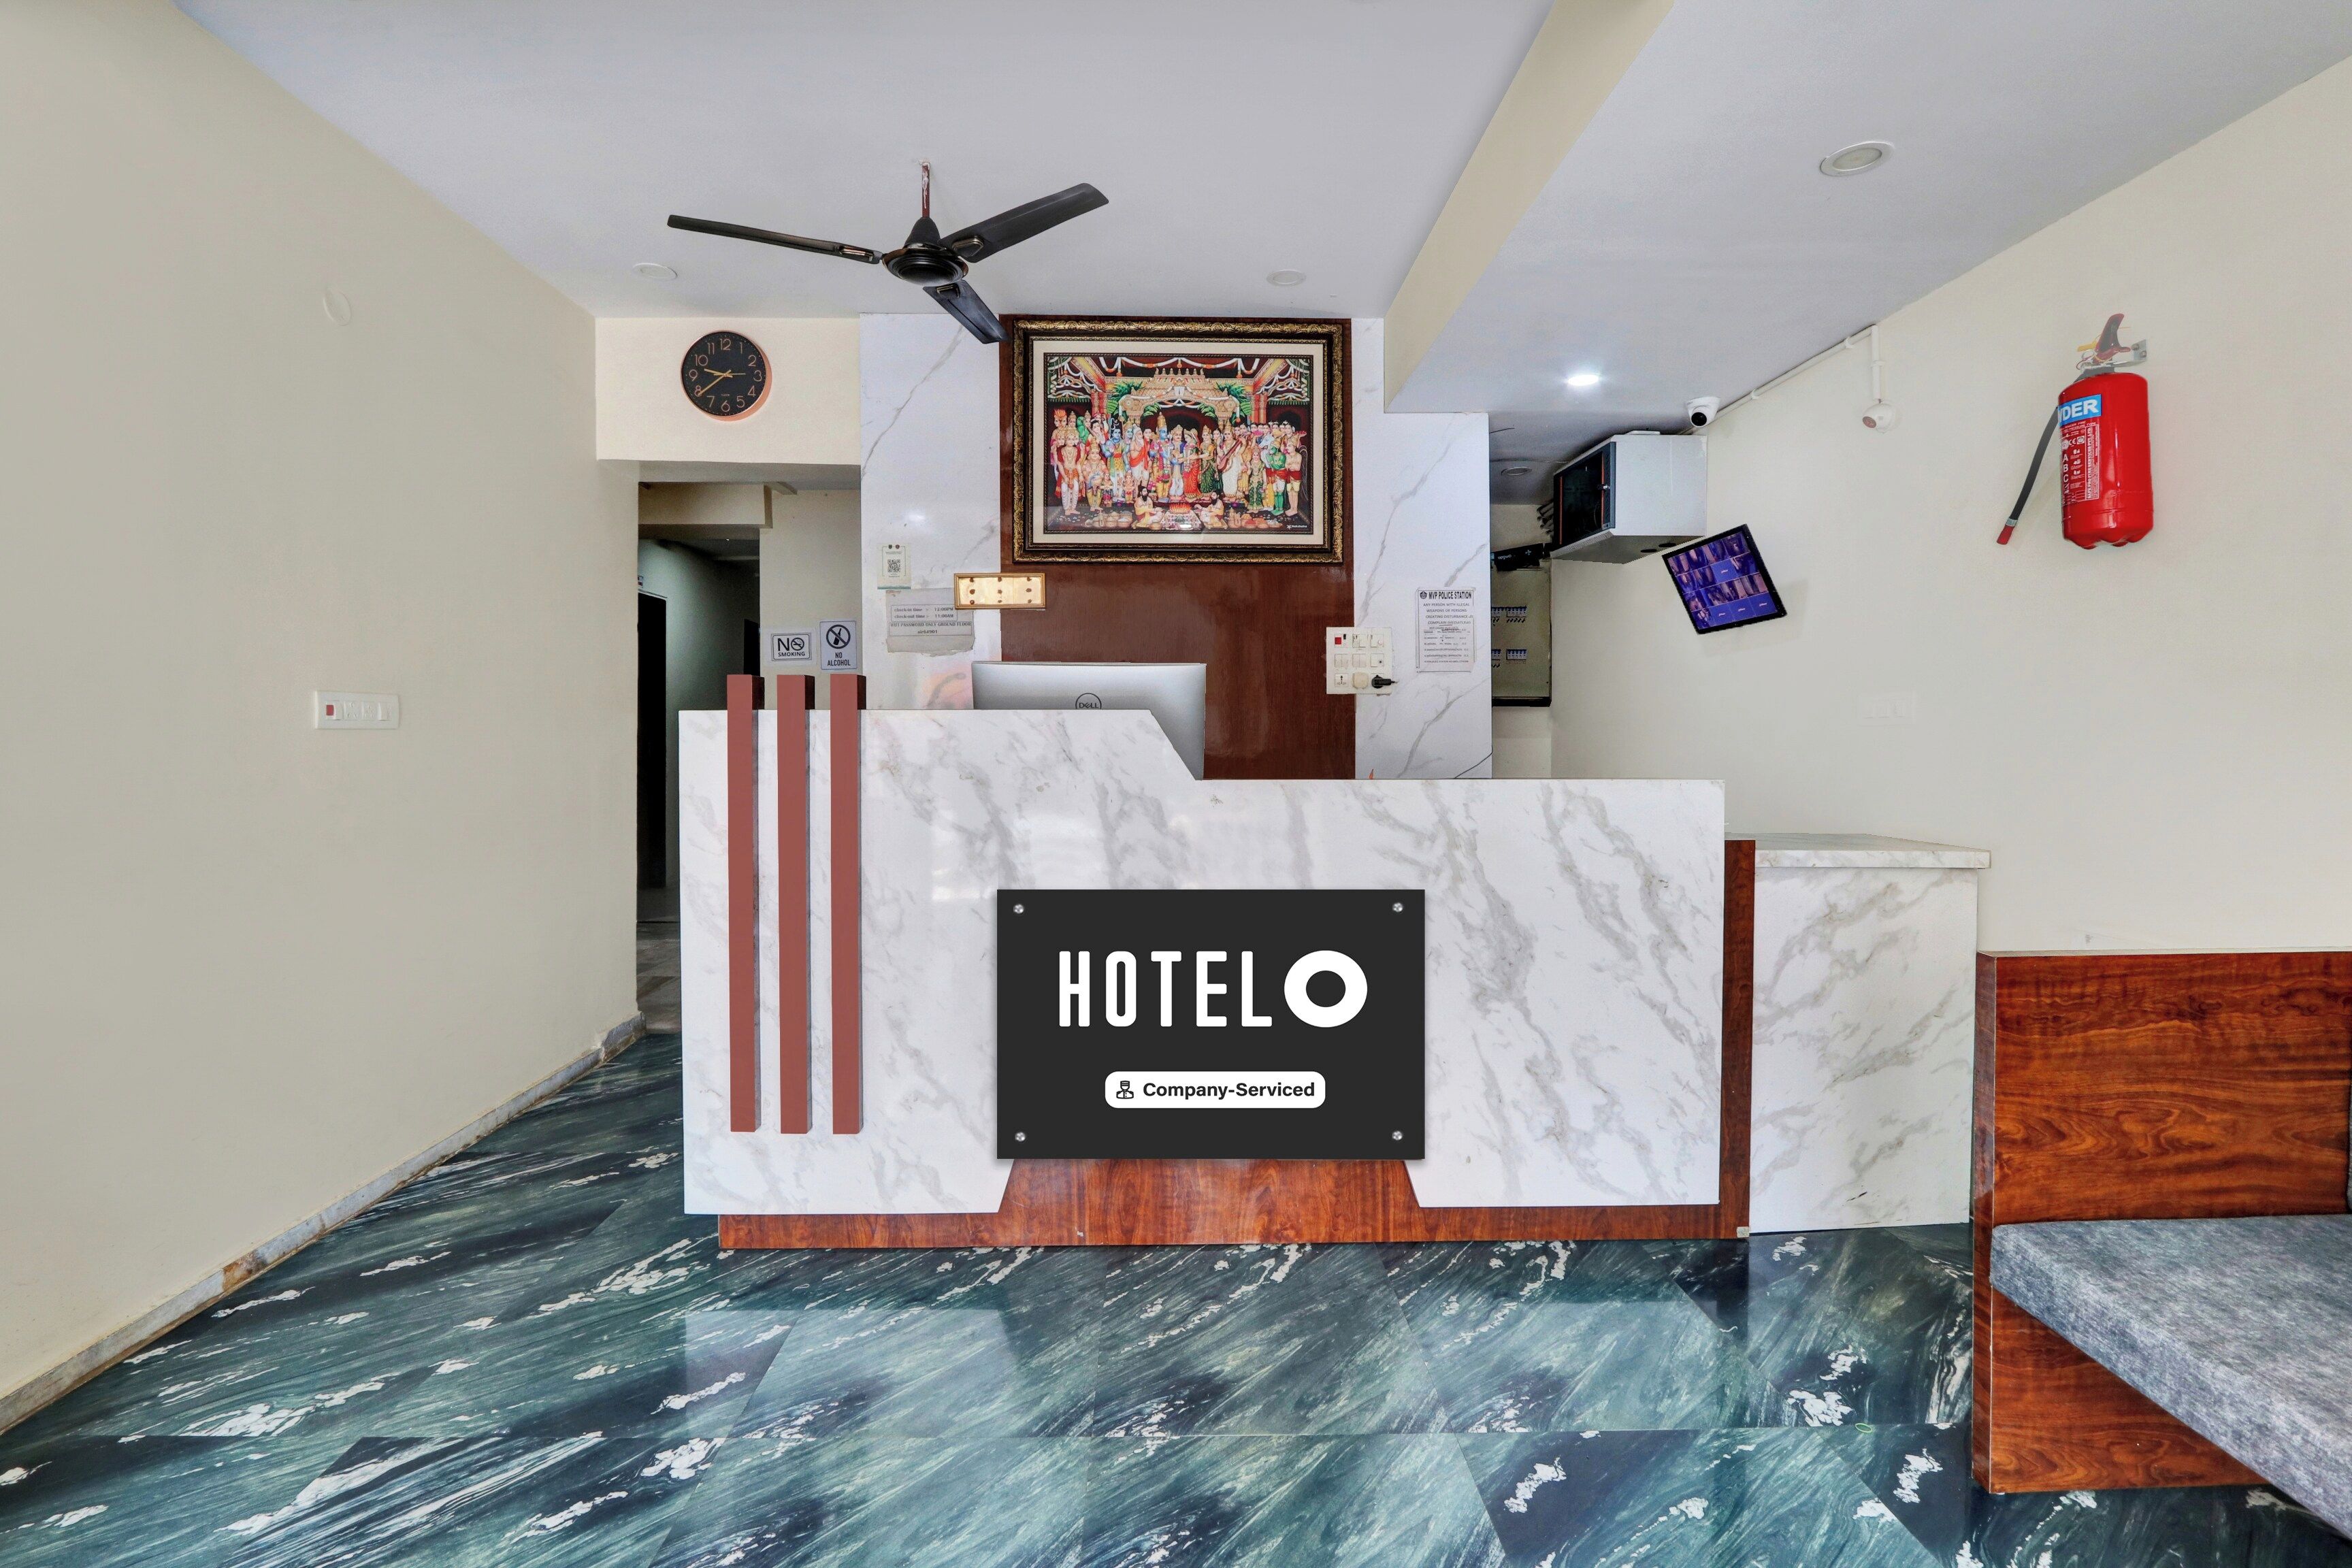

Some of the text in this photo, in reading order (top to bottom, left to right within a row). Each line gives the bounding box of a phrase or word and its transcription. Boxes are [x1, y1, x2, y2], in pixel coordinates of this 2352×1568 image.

[707, 342, 715, 355] 11
[720, 339, 732, 350] 12
[740, 342, 742, 354] 1
[694, 354, 708, 366] 10
[748, 355, 756, 367] 2
[689, 370, 698, 381] 9
[753, 370, 762, 382] 3
[694, 385, 702, 397] 8
[747, 385, 756, 397] 4
[706, 395, 715, 408] 7
[721, 400, 730, 412] 6
[736, 395, 745, 408] 5
[2063, 454, 2068, 462] A
[2063, 464, 2068, 472] B
[2063, 474, 2068, 483] C
[1059, 950, 1368, 1028] HOTEL O
[1143, 1082, 1316, 1100] Company-Serviced
